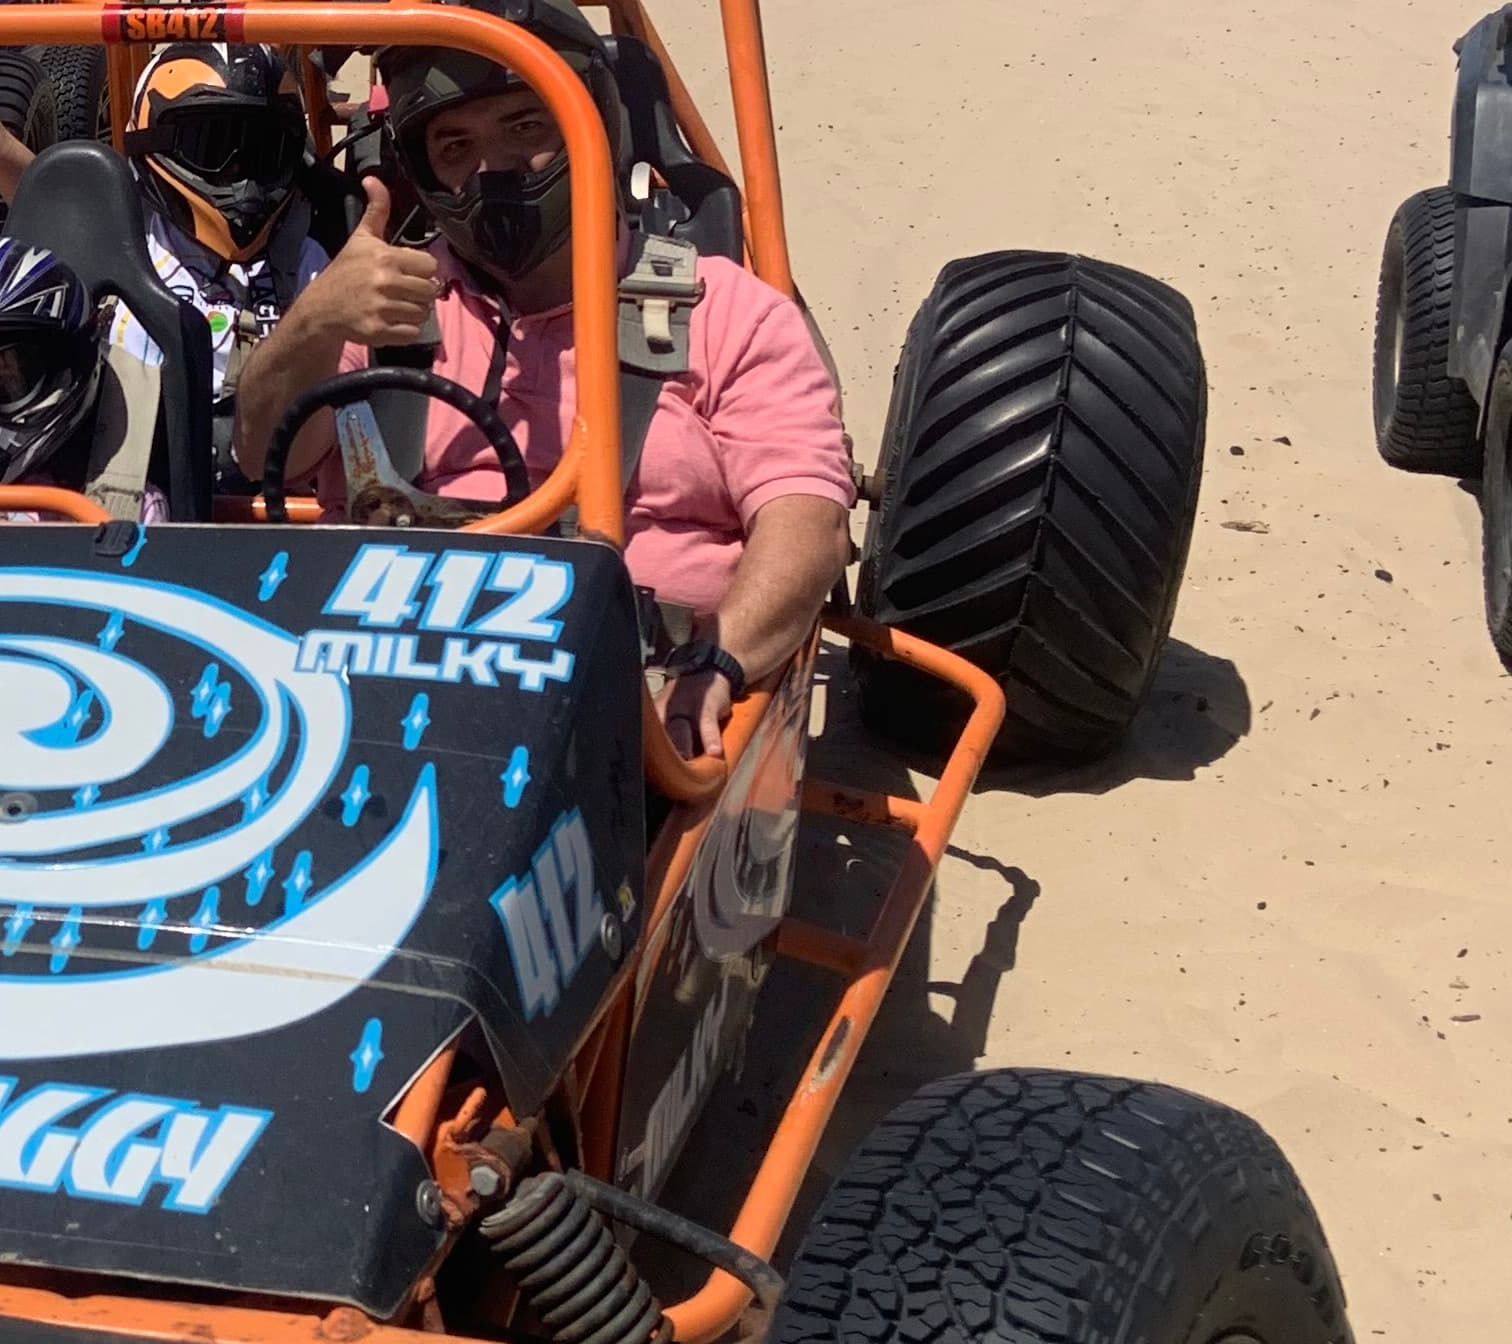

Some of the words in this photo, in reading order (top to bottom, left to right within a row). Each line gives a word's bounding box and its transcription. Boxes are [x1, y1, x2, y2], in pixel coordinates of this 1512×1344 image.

[126, 7, 218, 39] SB412
[321, 544, 575, 643] 412
[294, 629, 576, 693] MILKY
[488, 805, 604, 1024] 412
